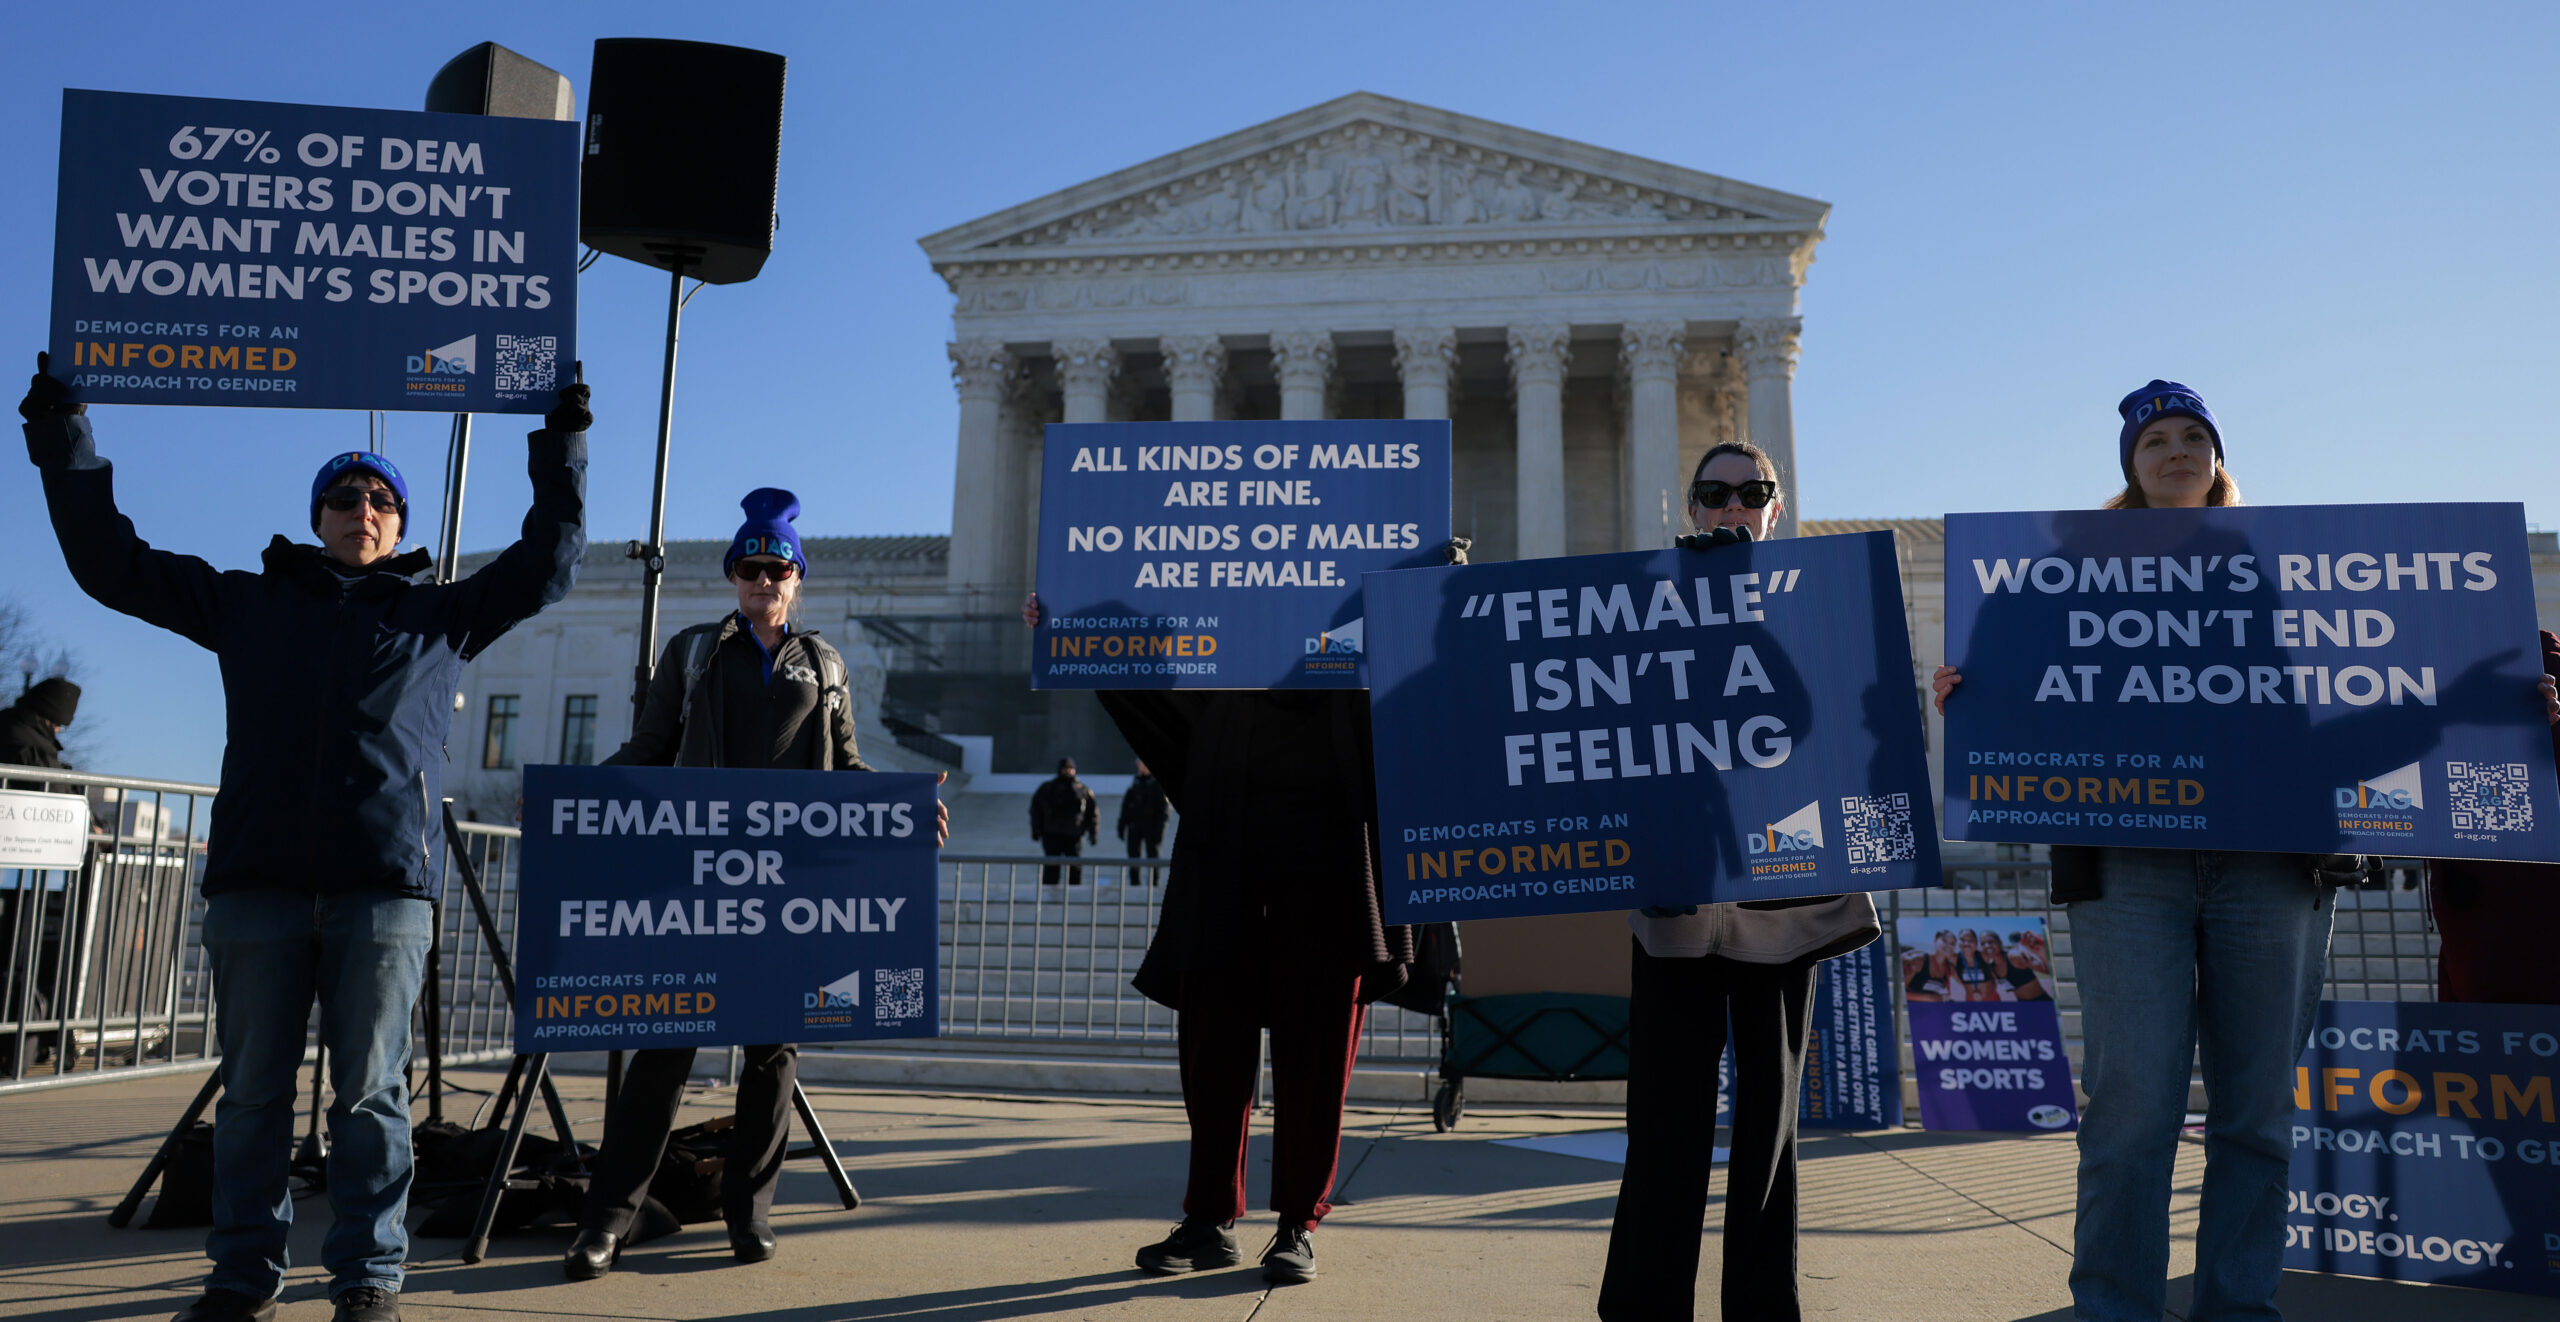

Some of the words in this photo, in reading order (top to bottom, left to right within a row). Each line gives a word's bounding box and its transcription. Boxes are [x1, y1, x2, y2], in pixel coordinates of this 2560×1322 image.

[169, 125, 281, 164] 67%
[297, 133, 365, 168] OF
[381, 137, 484, 175] DEM
[139, 168, 333, 212] VOTERS
[351, 179, 510, 219] DON'T
[116, 213, 279, 253] WANT
[295, 222, 456, 262] MALES
[473, 229, 524, 263] IN
[83, 258, 352, 302] WOMEN'S
[369, 268, 551, 309] SPORTS
[75, 320, 209, 337] DEMOCRATS
[218, 324, 261, 338] FOR
[269, 325, 299, 339] AN
[74, 342, 297, 372] INFORMED
[72, 373, 181, 391] APPROACH
[185, 376, 214, 391] TO
[217, 377, 296, 392] GENDER
[407, 383, 465, 391] INFORMED
[495, 392, 527, 400] di-ag.org
[2136, 395, 2206, 424] DIAG
[1071, 447, 1127, 472] ALL
[1138, 445, 1243, 471] KINDS
[1253, 444, 1299, 470] OF
[1309, 443, 1421, 469] MALES
[1164, 482, 1227, 506] ARE
[1239, 480, 1321, 506] FINE.
[745, 537, 794, 560] DIAG
[1068, 526, 1124, 552] NO
[1134, 525, 1240, 551] KINDS
[1251, 524, 1297, 550] OF
[1307, 524, 1420, 550] MALES
[1135, 563, 1198, 588] ARE
[1210, 561, 1346, 587] FEMALE.
[1972, 554, 2258, 595] WOMEN'S
[2279, 551, 2497, 592] RIGHTS
[1052, 617, 1149, 629] DEMOCRATS
[1157, 617, 1188, 628] FOR
[1195, 616, 1218, 628] AN
[2068, 609, 2253, 648] DON'T
[2274, 609, 2395, 648] END
[1051, 635, 1217, 657] INFORMED
[1049, 662, 1128, 675] APPROACH
[1132, 663, 1152, 674] TO
[1156, 663, 1216, 675] GENDER
[1510, 649, 1696, 712] ISN'T
[1723, 644, 1775, 697] A
[2034, 665, 2102, 702] AT
[2117, 664, 2437, 706] ABORTION
[1504, 715, 1792, 787] FEELING
[1968, 751, 2106, 768] DEMOCRATS
[2116, 753, 2161, 768] FOR
[2172, 754, 2205, 769] AN
[1969, 775, 2205, 806] INFORMED
[23, 807, 73, 823] CLOSED
[552, 799, 729, 836] FEMALE
[746, 801, 914, 838] SPORTS
[1403, 820, 1536, 843] DEMOCRATS
[1546, 816, 1588, 833] FOR
[1598, 813, 1629, 829] AN
[1968, 809, 2081, 826] APPROACH
[2085, 811, 2114, 826] TO
[2118, 812, 2207, 830] GENDER
[2338, 820, 2413, 831] INFORMED
[2453, 832, 2497, 842] di-ag.org
[693, 849, 785, 885] FOR
[1406, 838, 1631, 881] INFORMED
[1752, 862, 1816, 875] INFORMED
[1850, 865, 1887, 875] di-ag.org
[1408, 881, 1516, 905] APPROACH
[1520, 880, 1549, 898] TO
[1552, 875, 1635, 895] GENDER
[1752, 874, 1784, 882] APPROACH
[560, 899, 766, 936] FEMALES
[781, 897, 906, 934] ONLY
[536, 974, 644, 988] DEMOCRATS
[652, 973, 686, 986] FOR
[693, 973, 717, 985] AN
[1831, 959, 1844, 1008] PLAYING
[1846, 967, 1858, 999] THEM
[1861, 968, 1873, 996] TWO
[536, 992, 716, 1019] INFORMED
[1863, 997, 1876, 1037] LITTLE
[534, 1023, 623, 1039] APPROACH
[627, 1023, 649, 1035] TO
[652, 1020, 716, 1035] GENDER
[804, 1016, 852, 1024] INFORMED
[1833, 1009, 1846, 1043] FIELD
[1848, 1000, 1861, 1053] GETTING
[1951, 1012, 2017, 1032] SAVE
[1835, 1043, 1846, 1060] BY
[1920, 1039, 2055, 1061] WOMEN'S
[2308, 1026, 2480, 1054] OCRATS
[1836, 1060, 1847, 1069] A
[1851, 1053, 1863, 1081] RUN
[1940, 1069, 2045, 1090] SPORTS
[1853, 1082, 1865, 1114] OVER
[2450, 1134, 2504, 1161] TO
[2324, 1227, 2514, 1270] IDEOLOGY.
